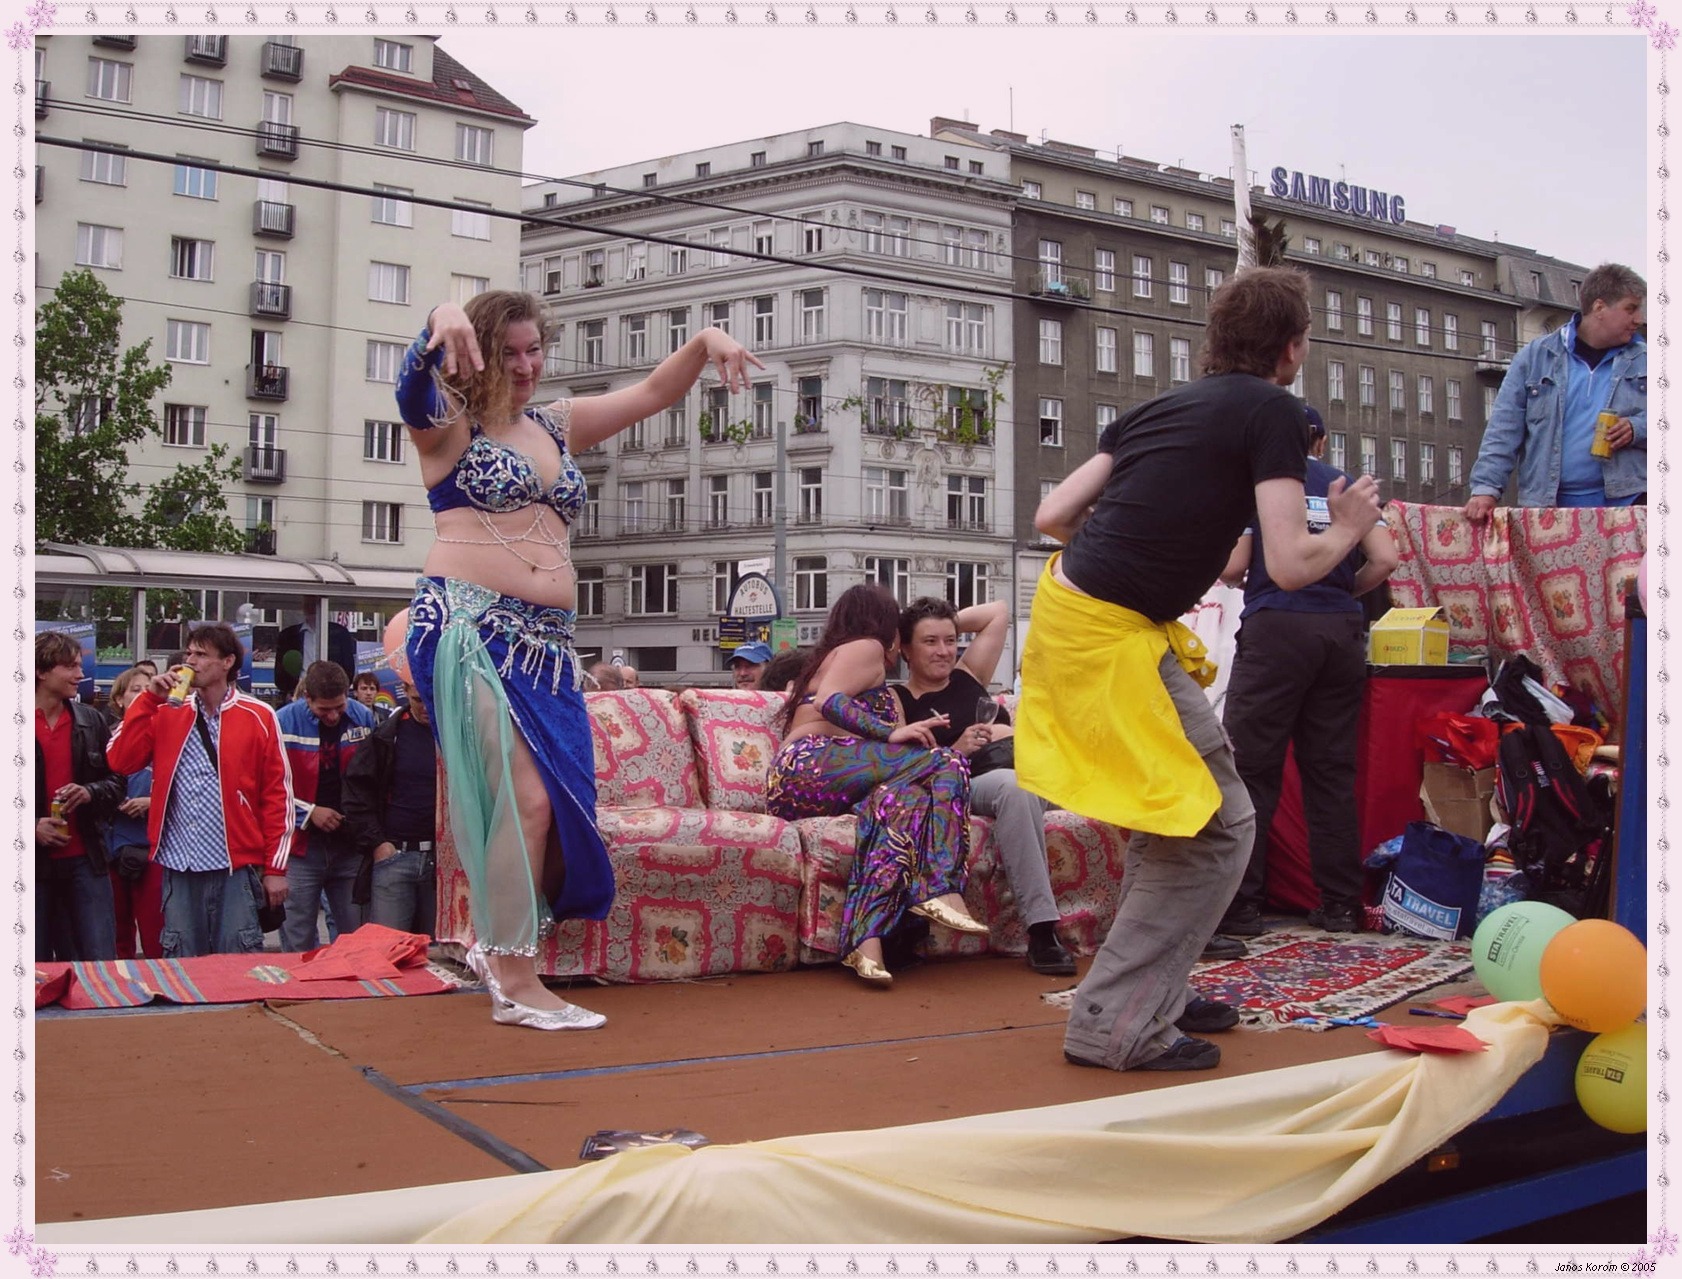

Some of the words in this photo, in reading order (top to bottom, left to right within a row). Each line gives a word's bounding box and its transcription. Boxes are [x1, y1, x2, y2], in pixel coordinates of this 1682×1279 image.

[1271, 166, 1406, 225] SAMSUNG
[740, 579, 768, 597] AUTOBUS
[734, 603, 773, 616] HALTESTELLE
[692, 628, 719, 642] HEL
[1405, 892, 1452, 926] TRAVEL
[1488, 942, 1502, 962] STA
[1496, 915, 1518, 941] TRAVEL
